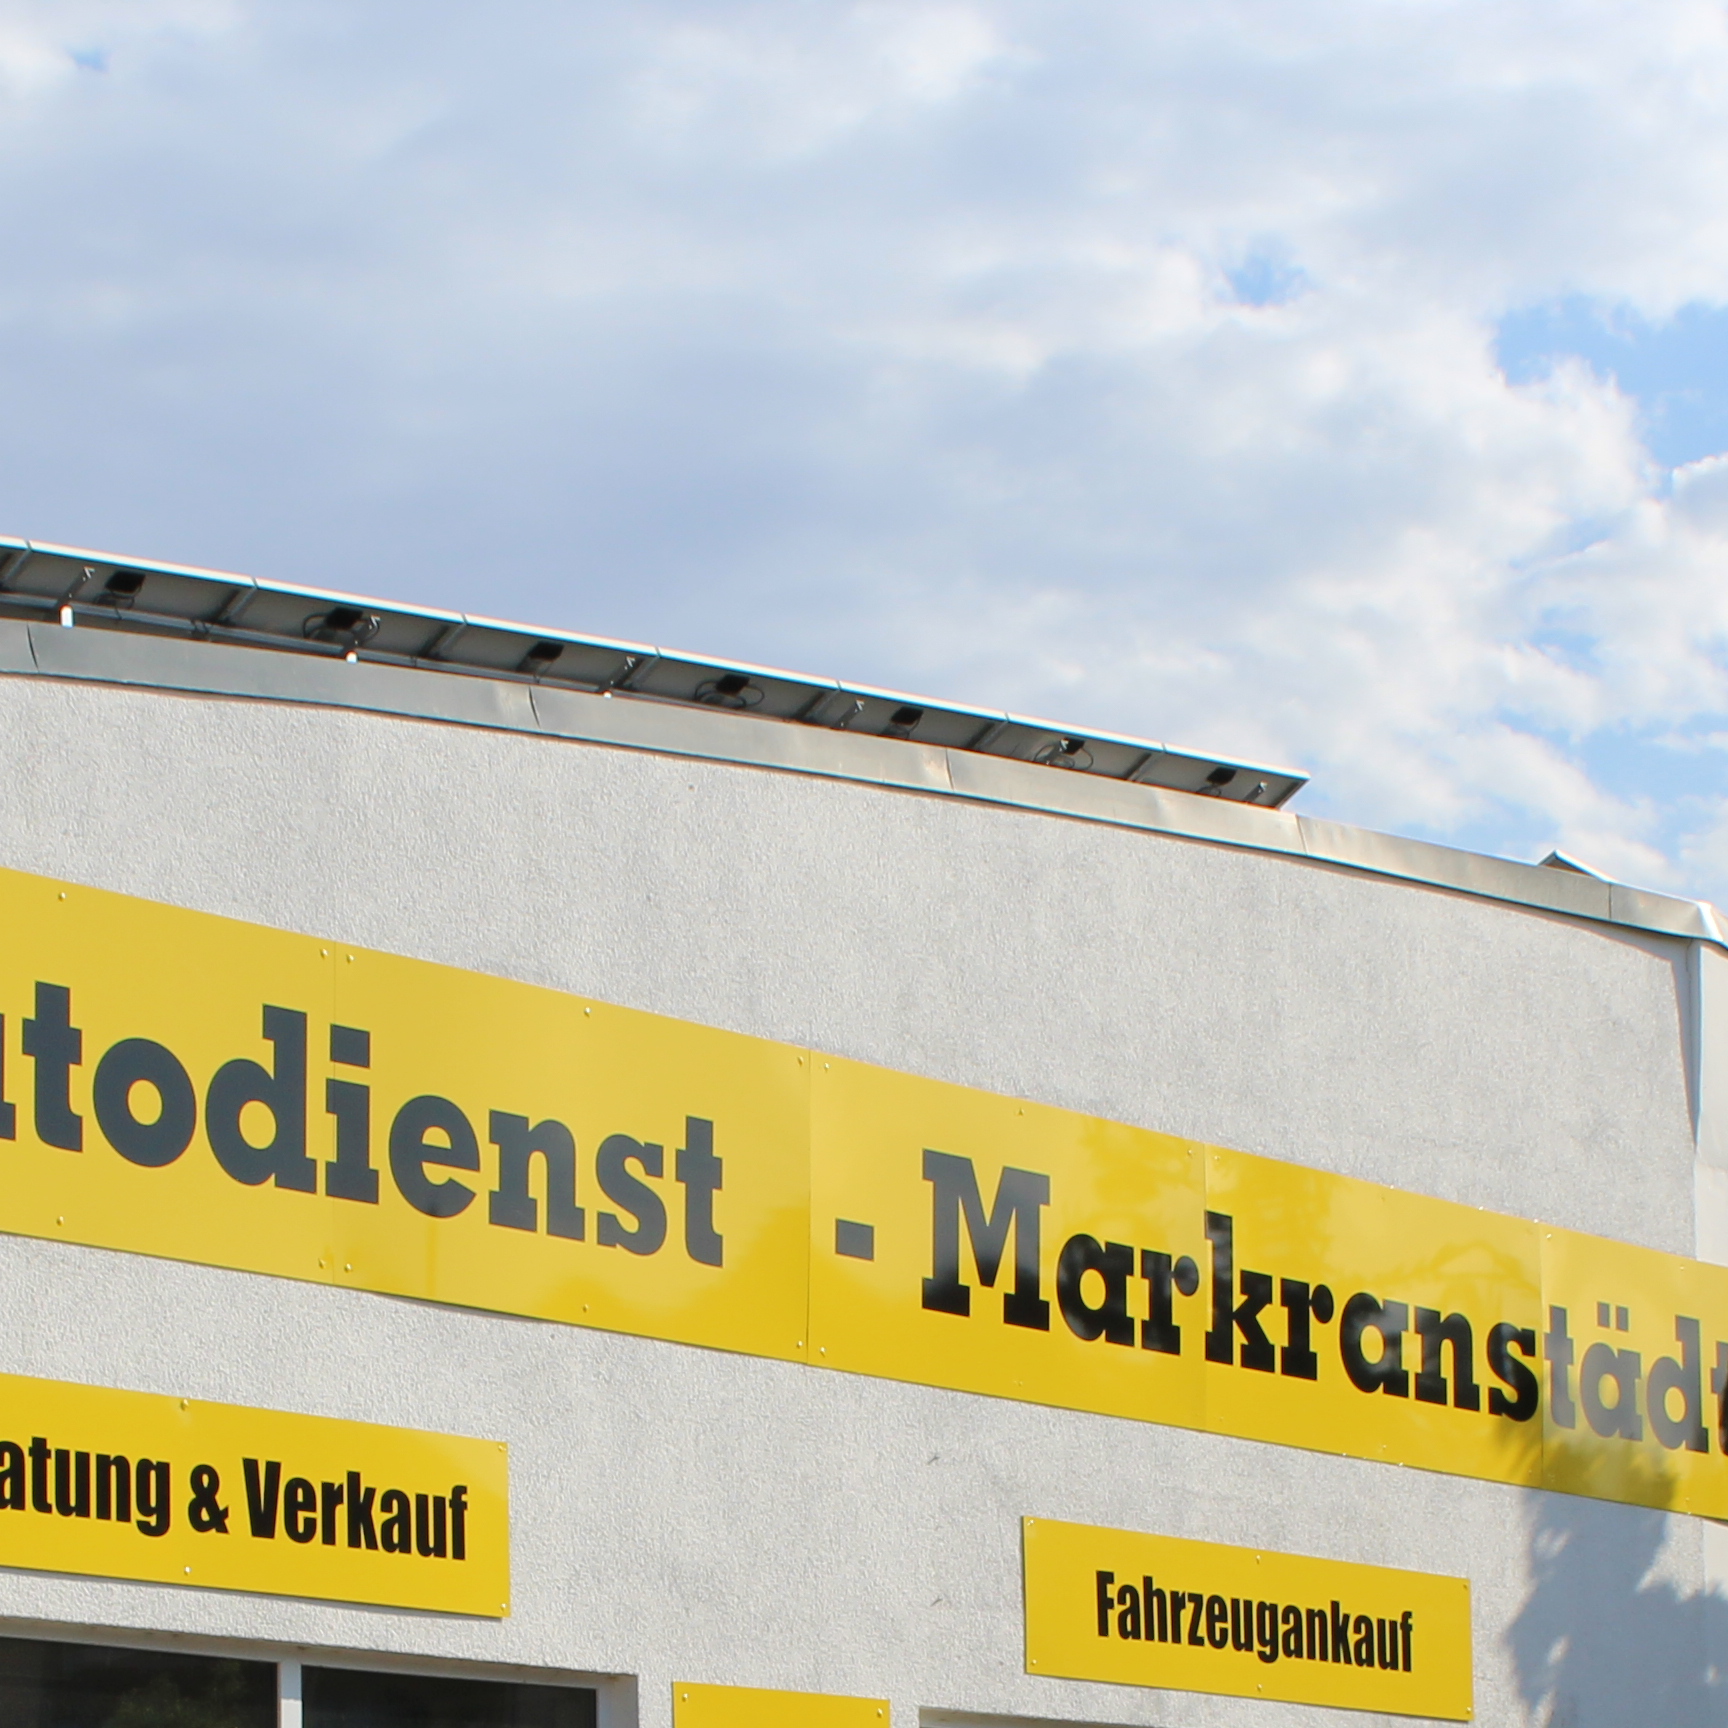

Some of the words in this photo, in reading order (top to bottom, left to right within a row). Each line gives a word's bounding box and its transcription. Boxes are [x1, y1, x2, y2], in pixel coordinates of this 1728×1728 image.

[188, 1464, 229, 1534] &
[242, 1457, 468, 1561] Verkauf
[1096, 1570, 1413, 1672] Fahrzeugankauf
